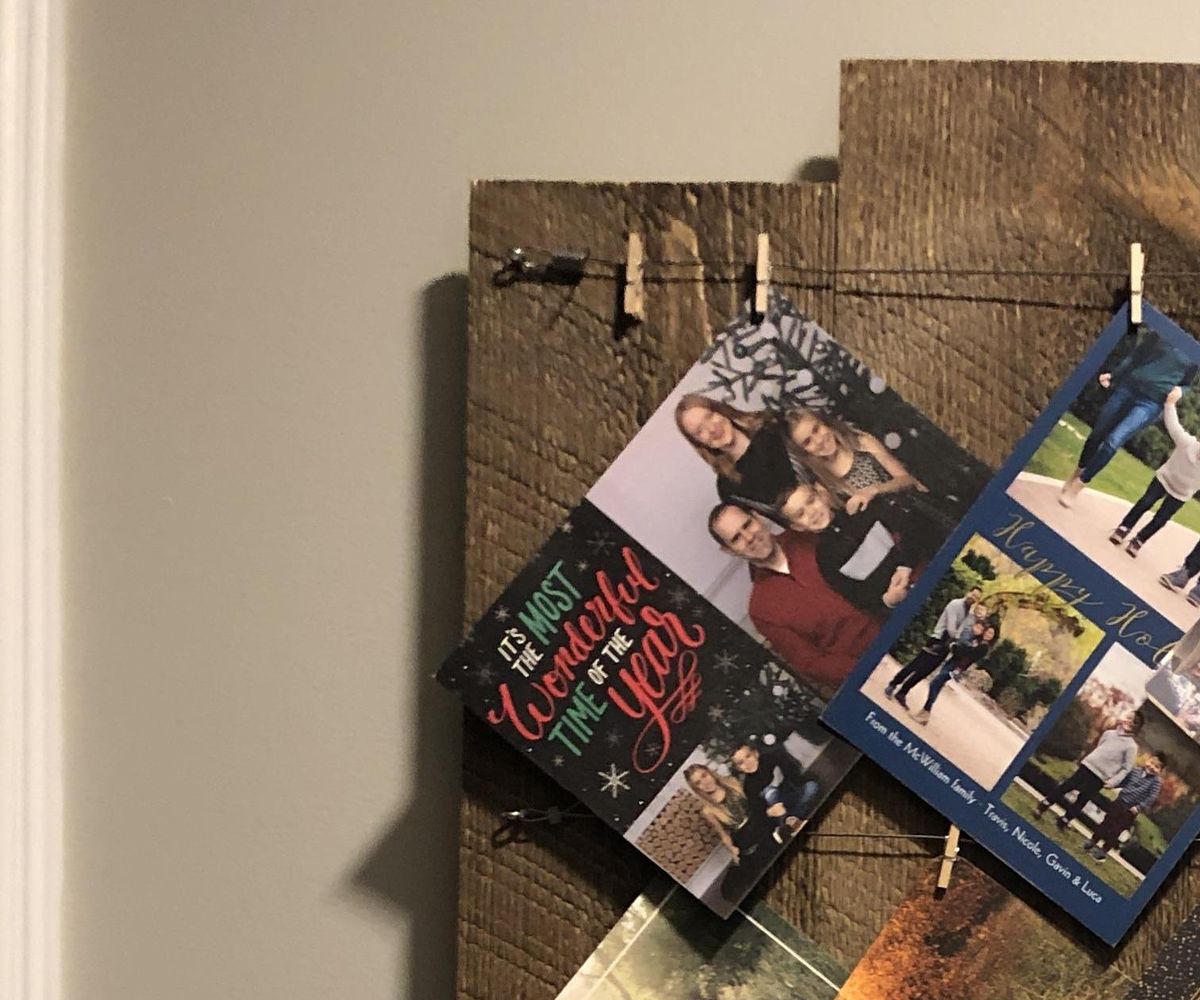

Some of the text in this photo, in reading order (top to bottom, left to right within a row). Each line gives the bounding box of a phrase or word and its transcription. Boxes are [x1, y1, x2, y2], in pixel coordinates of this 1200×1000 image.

[487, 547, 659, 741] Wonderful
[497, 560, 583, 678] IT'S THE MOST
[993, 511, 1176, 664] Happy Hol
[547, 627, 635, 757] TIME OF THE
[865, 711, 1103, 904] From the McWilliam family Travis, Nicole, Gavin & Luca
